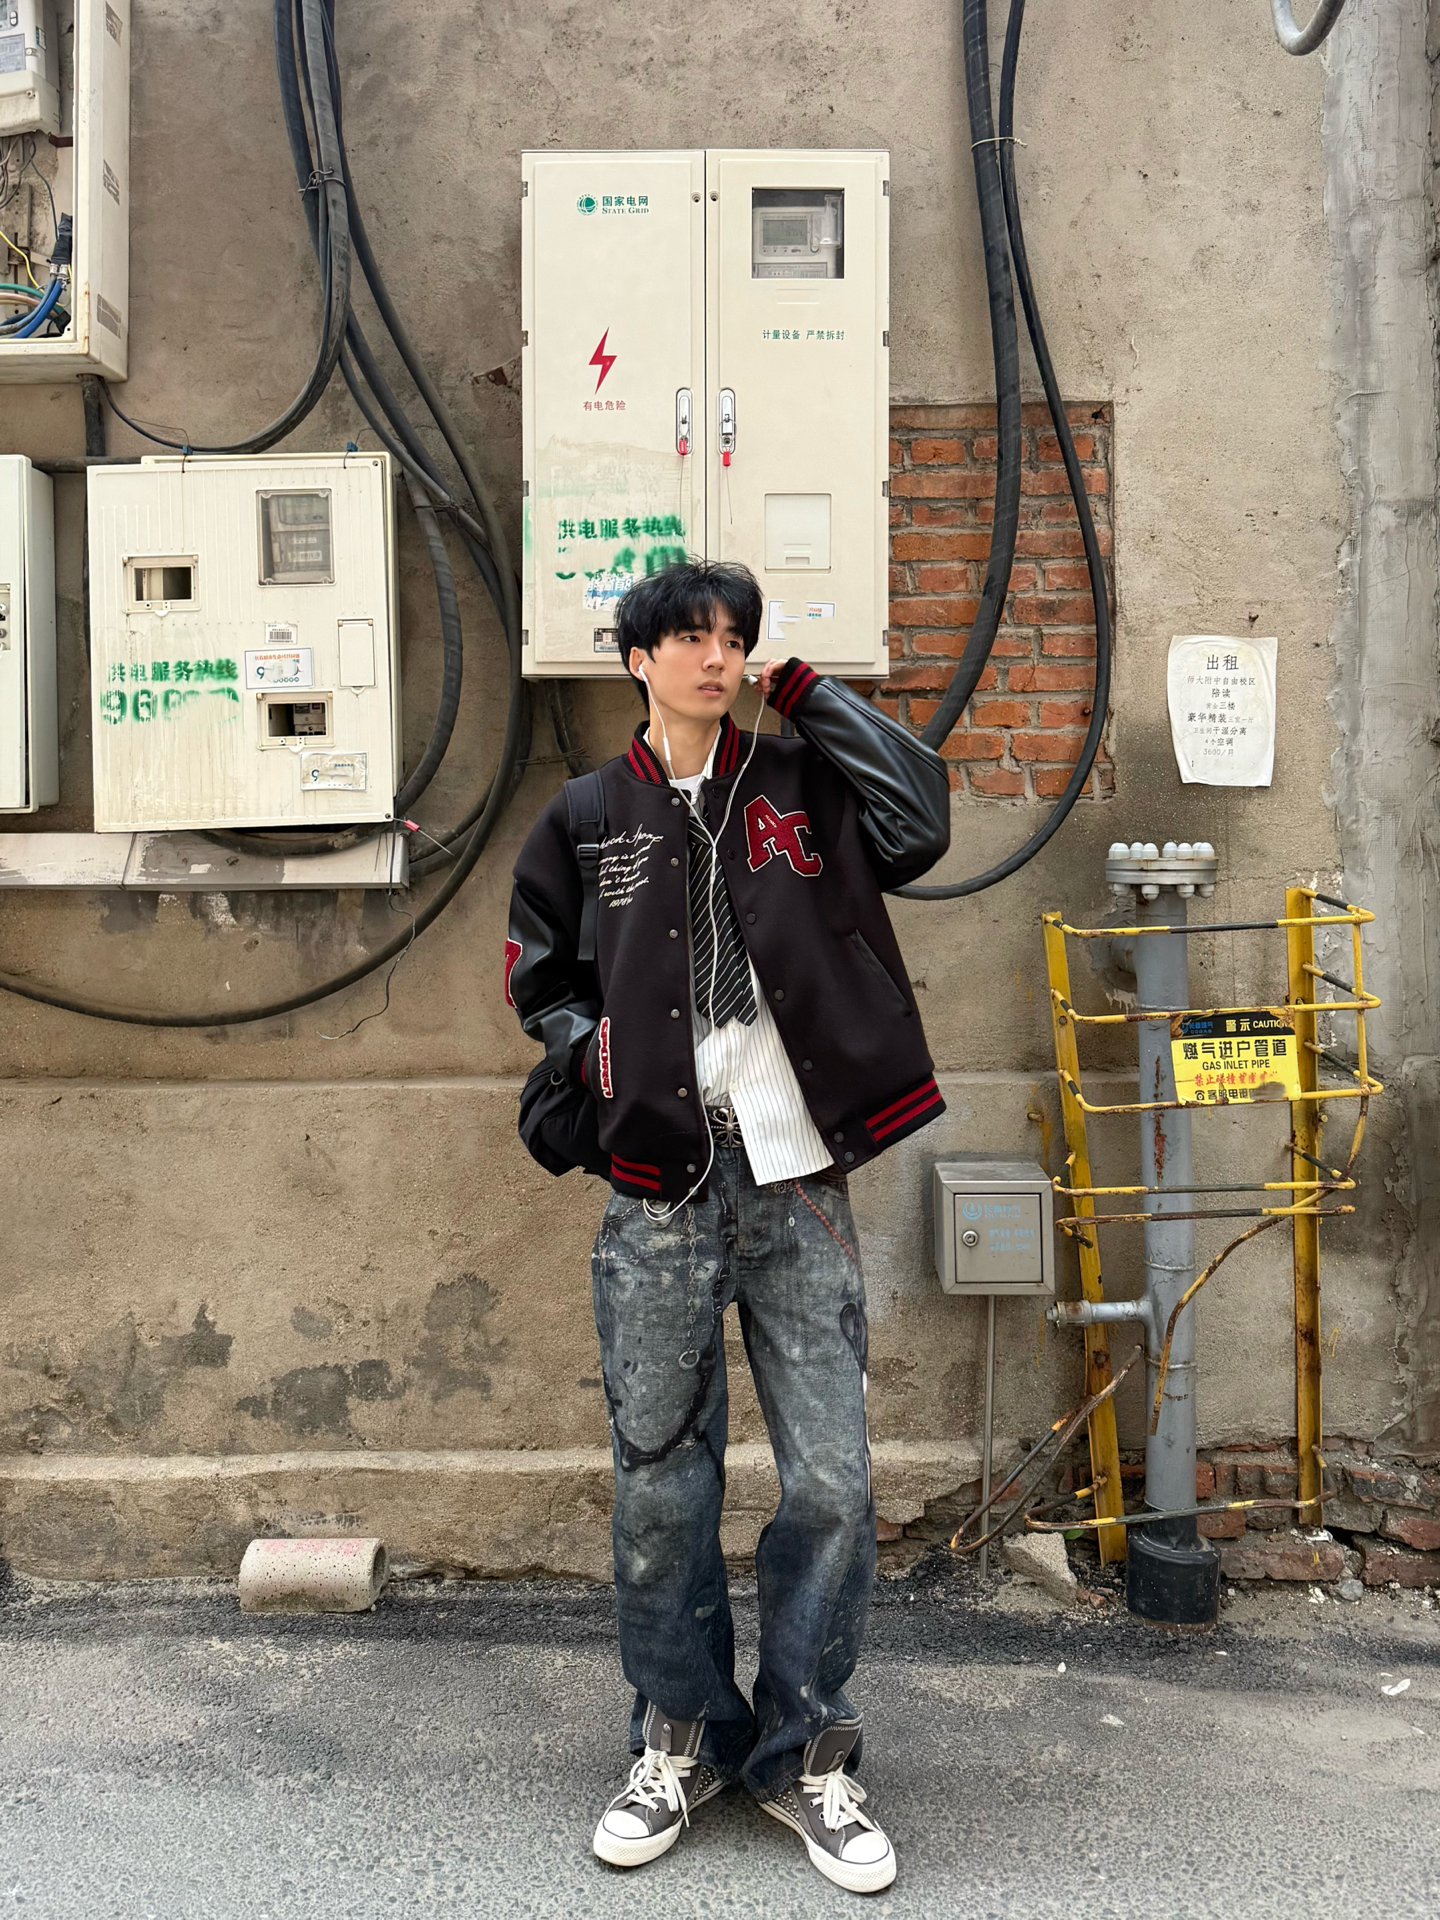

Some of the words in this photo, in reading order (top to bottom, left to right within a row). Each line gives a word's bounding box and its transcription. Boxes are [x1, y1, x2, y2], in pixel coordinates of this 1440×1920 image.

[602, 195, 649, 207] 国家电网
[762, 329, 801, 340] 计量设备
[806, 330, 845, 341] 严禁拆封
[583, 400, 626, 411] 有电危险
[1206, 654, 1239, 671] 出租
[1187, 675, 1256, 686] 师大附中自由校区
[1211, 688, 1231, 699] 陪读
[1225, 1018, 1251, 1033] 警示
[1183, 1039, 1287, 1060] 燃气进户管道
[1202, 1061, 1222, 1071] GAS
[1223, 1060, 1248, 1070] INLET
[1251, 1059, 1270, 1069] PIPE
